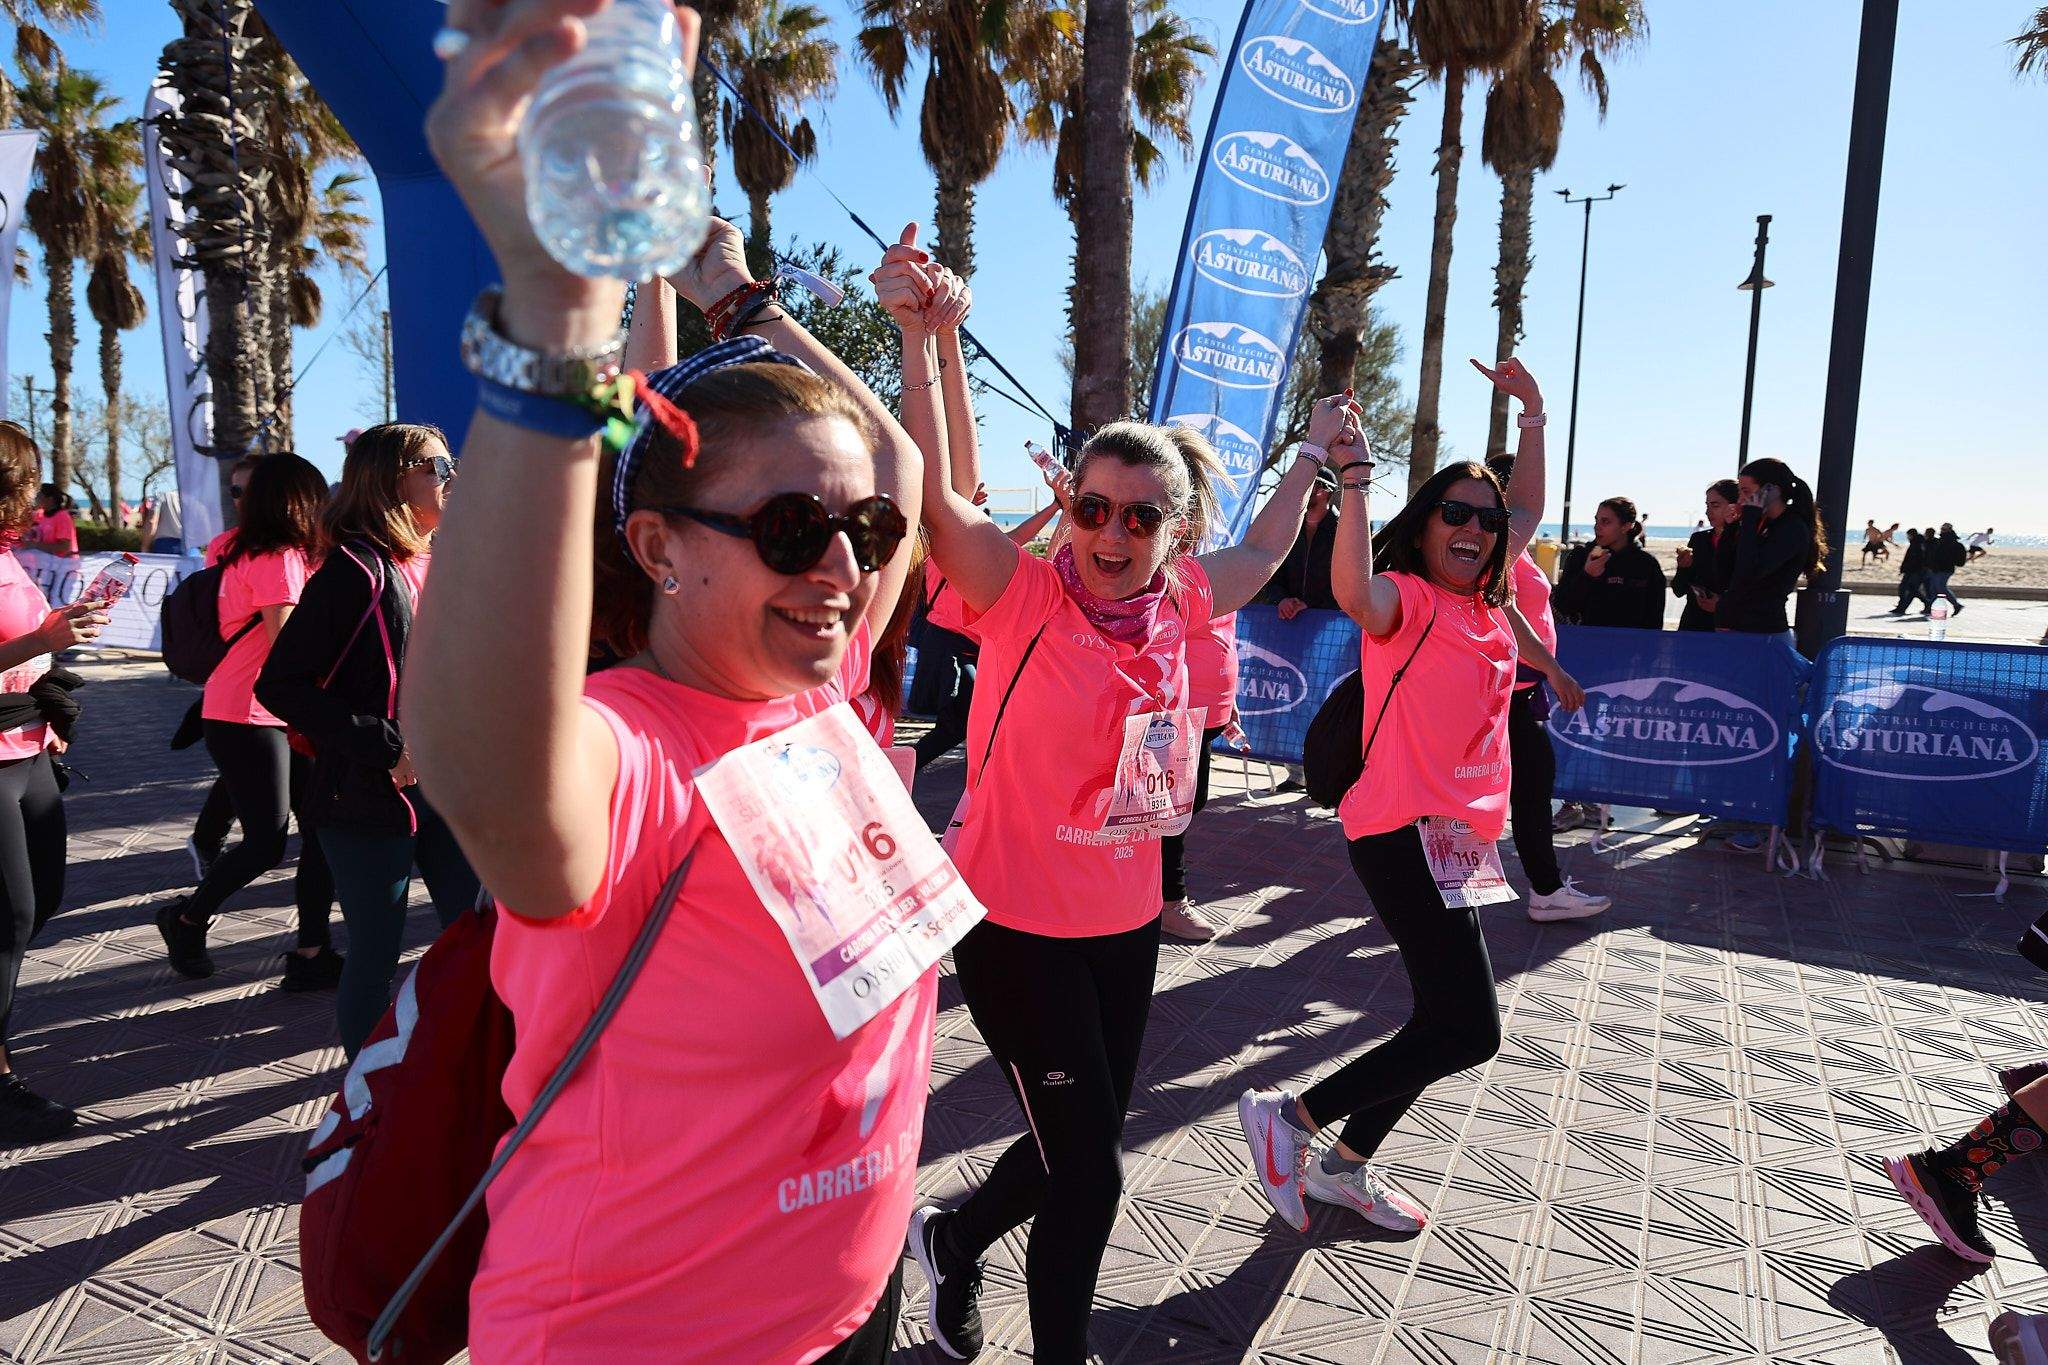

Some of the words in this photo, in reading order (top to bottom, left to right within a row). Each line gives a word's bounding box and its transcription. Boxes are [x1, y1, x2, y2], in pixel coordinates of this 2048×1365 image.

[1247, 46, 1345, 107] ASTURIANA
[1221, 142, 1319, 199] ASTURIANA
[1198, 241, 1300, 292] ASTURIANA
[1561, 705, 1760, 750] ASTURIANA
[1820, 707, 2019, 762] ASTURIANA
[1147, 769, 1175, 795] 016
[1454, 763, 1490, 779] CARRERA
[1151, 798, 1167, 810] 9314
[1113, 845, 1134, 860] 2025
[777, 1143, 895, 1214] CARRERA
